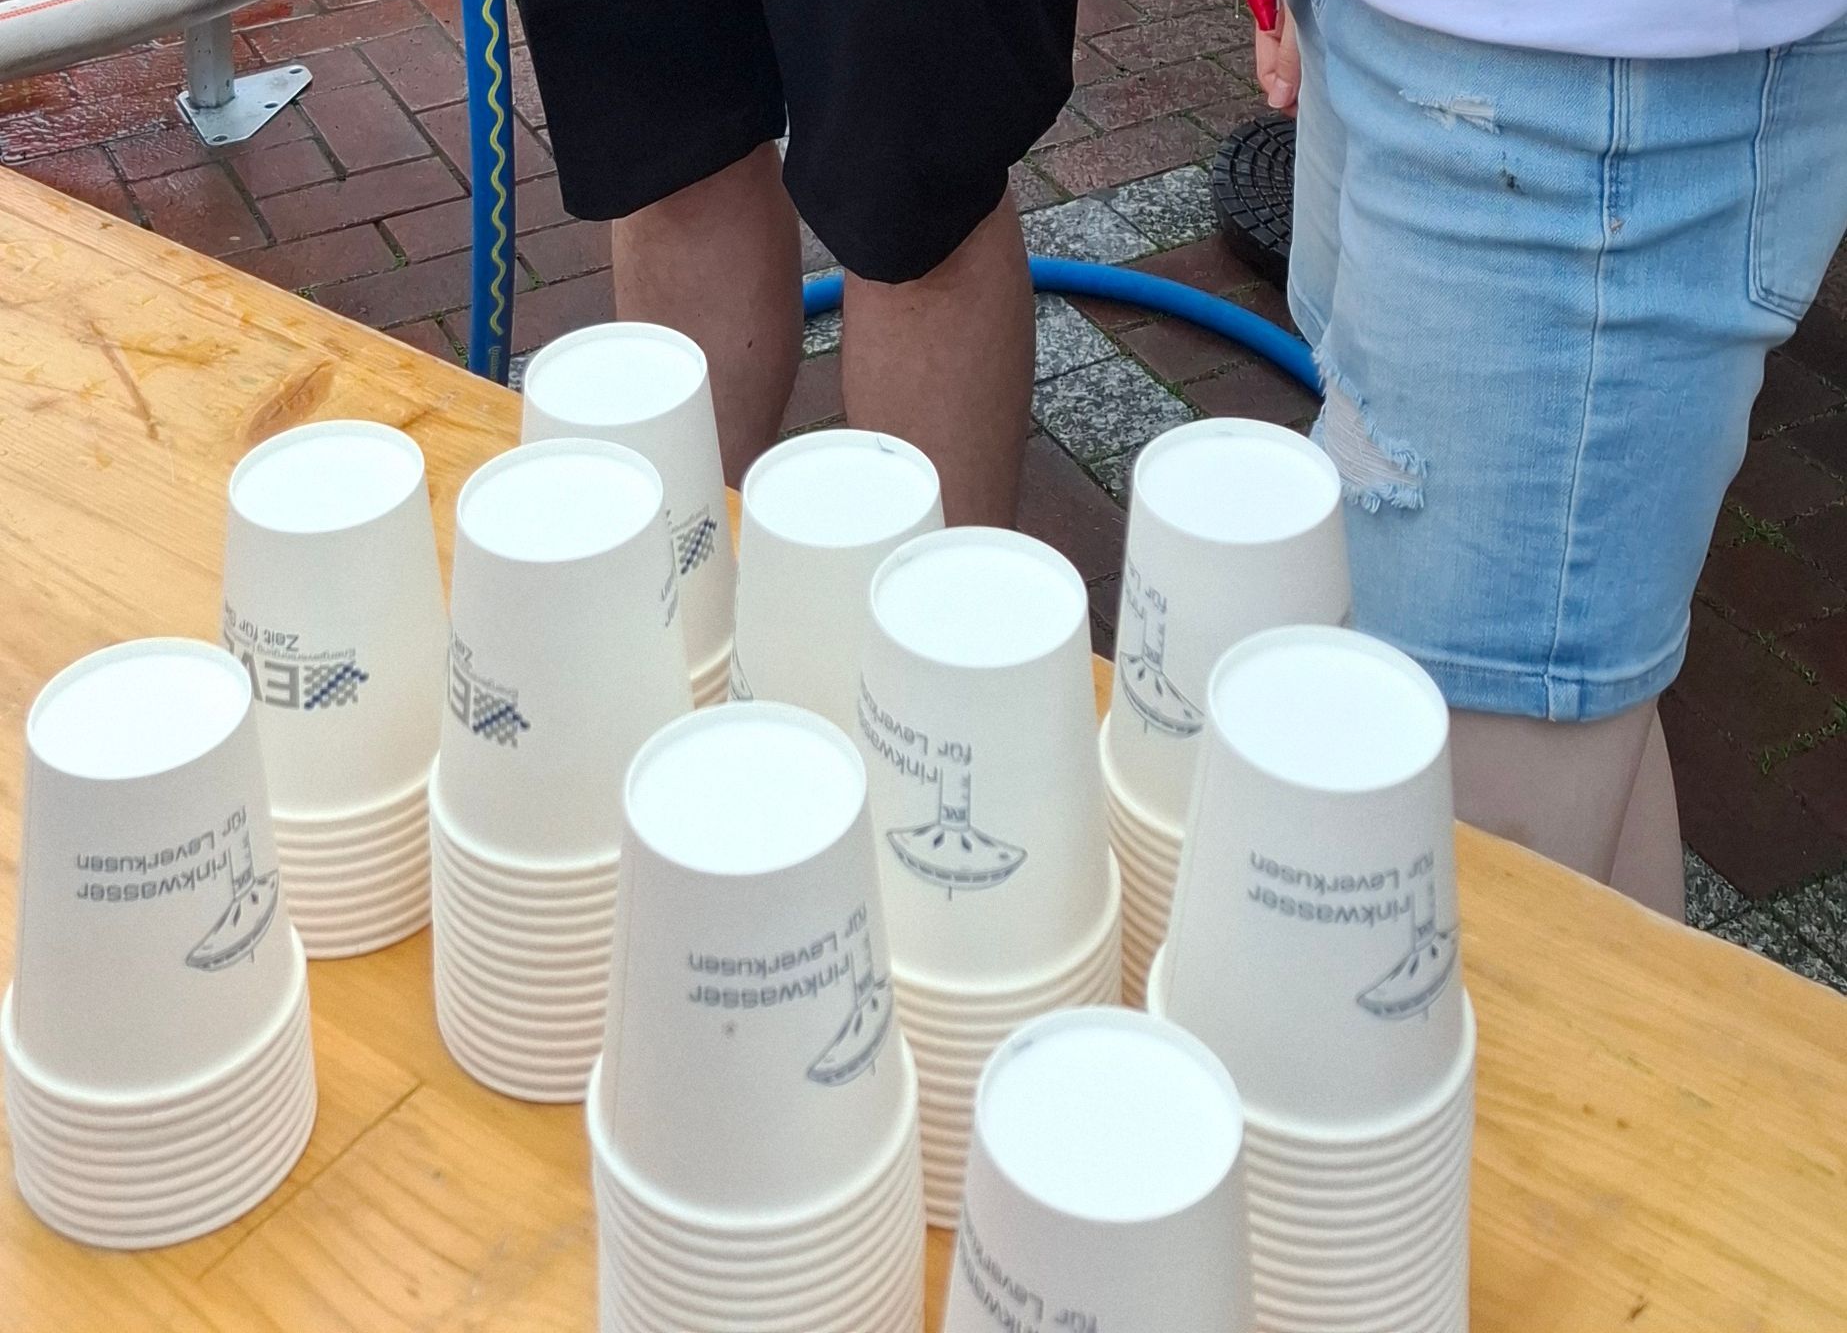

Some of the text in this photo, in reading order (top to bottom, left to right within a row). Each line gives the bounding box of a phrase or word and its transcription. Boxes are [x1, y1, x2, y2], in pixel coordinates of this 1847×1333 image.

[263, 629, 300, 652] Zeit
[938, 741, 972, 766] für
[77, 805, 247, 877] für Leverkusen
[1250, 850, 1435, 896] für Leverkusen
[688, 931, 838, 979] Leverkusen
